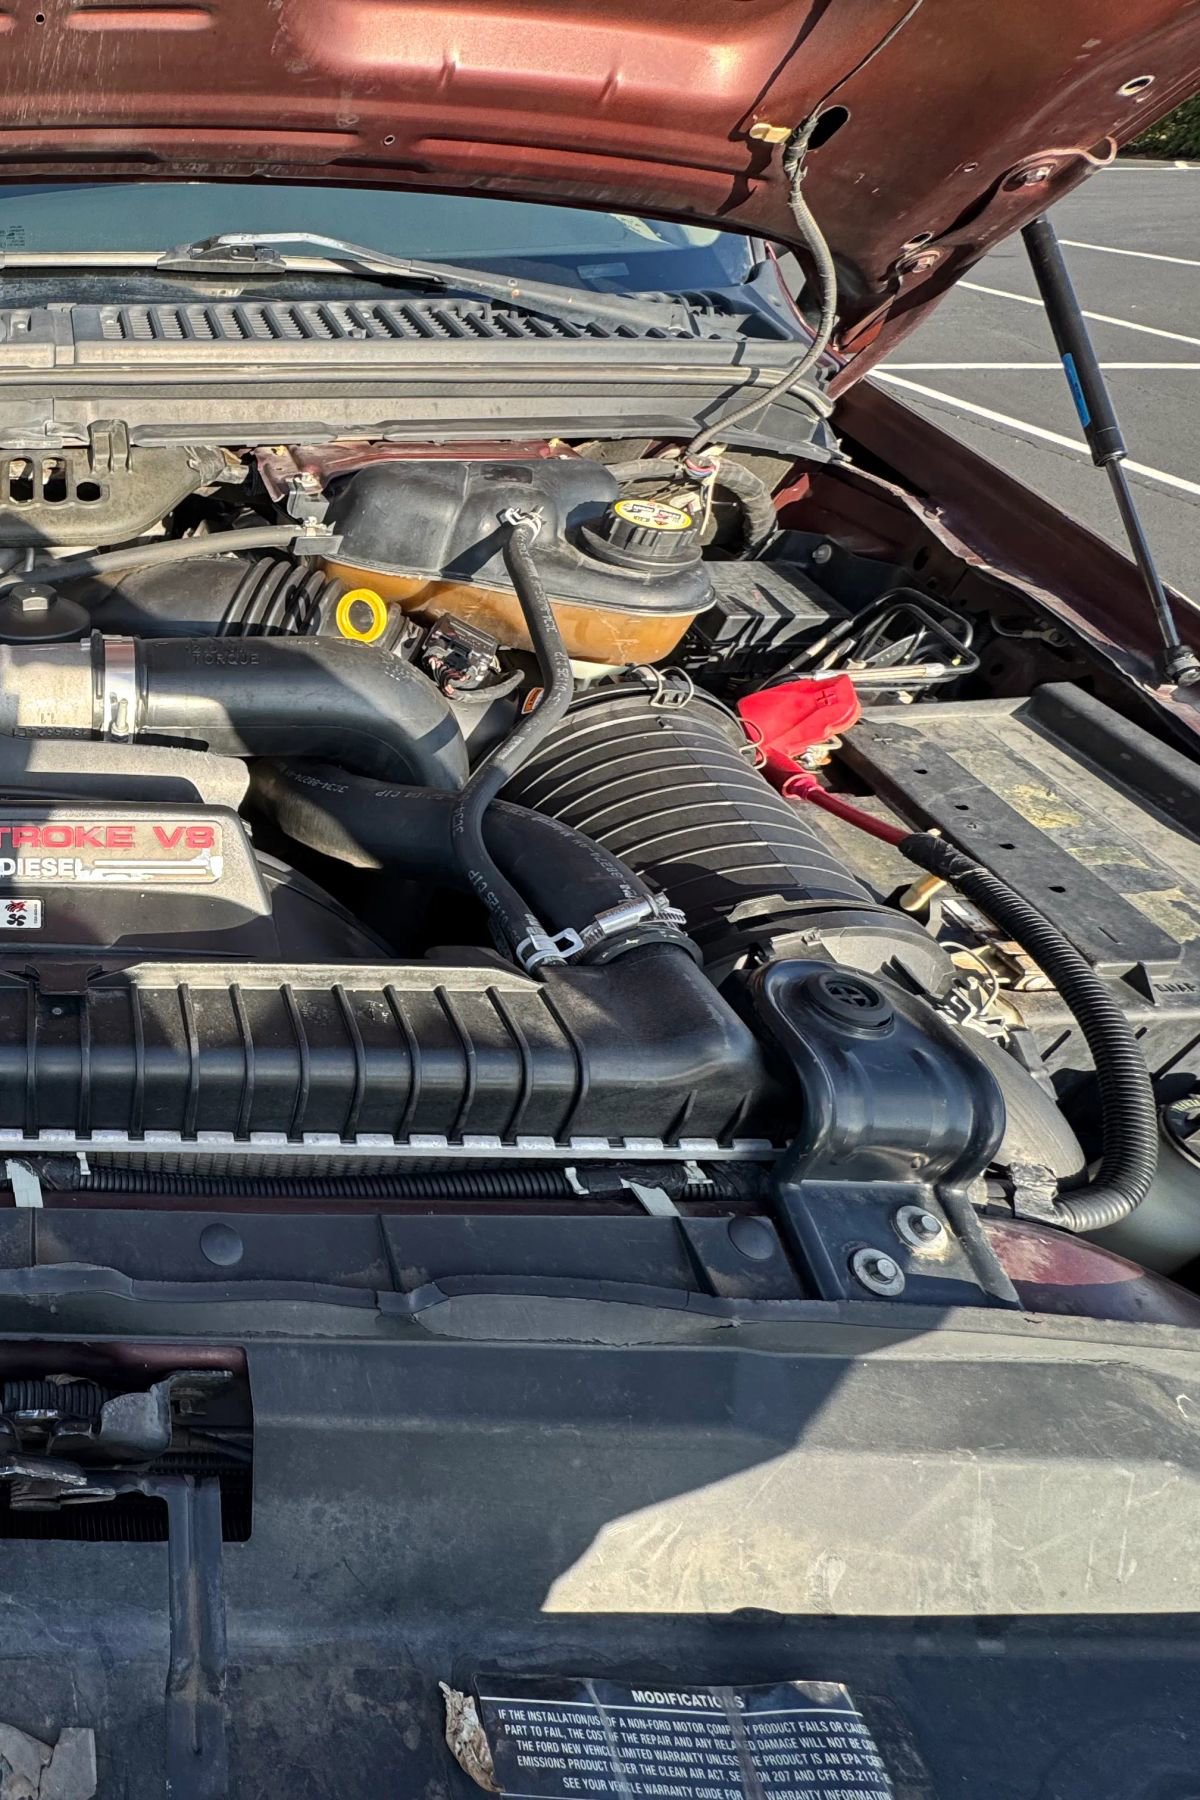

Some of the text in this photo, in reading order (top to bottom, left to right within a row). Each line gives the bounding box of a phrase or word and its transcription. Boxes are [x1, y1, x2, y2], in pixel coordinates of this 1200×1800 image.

[153, 826, 215, 849] V8
[0, 857, 87, 877] DIESEL
[632, 1690, 745, 1709] MODIFICATIOS
[498, 1709, 507, 1720] IF
[508, 1710, 527, 1722] THE
[619, 1717, 626, 1728] A
[627, 1718, 672, 1731] NON-FORD
[672, 1721, 704, 1734] MOTOR
[706, 1723, 750, 1737] COMPY
[752, 1722, 796, 1735] PRODUCT
[800, 1721, 829, 1733] FAILS
[830, 1721, 844, 1733] OR
[504, 1725, 527, 1737] PART
[530, 1726, 542, 1737] TO
[568, 1728, 585, 1740] THE
[585, 1729, 608, 1742] COST
[620, 1732, 639, 1744] THE
[640, 1733, 673, 1747] REPAIR
[674, 1736, 693, 1749] AND
[695, 1738, 713, 1750] ANY
[714, 1739, 755, 1751] RELAED
[757, 1738, 799, 1751] DAMAGE
[799, 1737, 826, 1749] WILL
[827, 1737, 848, 1749] NOT
[848, 1737, 862, 1749] BE
[516, 1740, 535, 1752] THE
[536, 1741, 560, 1754] FORD
[561, 1743, 583, 1756] NEW
[616, 1747, 653, 1760] LIMITED
[653, 1749, 704, 1764] WARRANTY
[705, 1753, 740, 1767] UNLESS
[763, 1753, 807, 1767] PRODUCT
[810, 1753, 824, 1765] IS
[825, 1753, 841, 1765] AN
[841, 1753, 862, 1766] EPA
[517, 1755, 567, 1770] EMISSIONS
[568, 1758, 609, 1772] PRODUCT
[639, 1763, 657, 1776] THE
[658, 1764, 689, 1779] CLEAN
[689, 1768, 706, 1780] AIR
[773, 1770, 791, 1783] 207
[793, 1769, 817, 1782] AND
[818, 1769, 839, 1781] CFR
[562, 1777, 581, 1790] SEE
[581, 1778, 608, 1793] YOUR
[642, 1782, 693, 1799] WARRANTY
[695, 1786, 724, 1800] GUIDE
[723, 1788, 743, 1800] FOR
